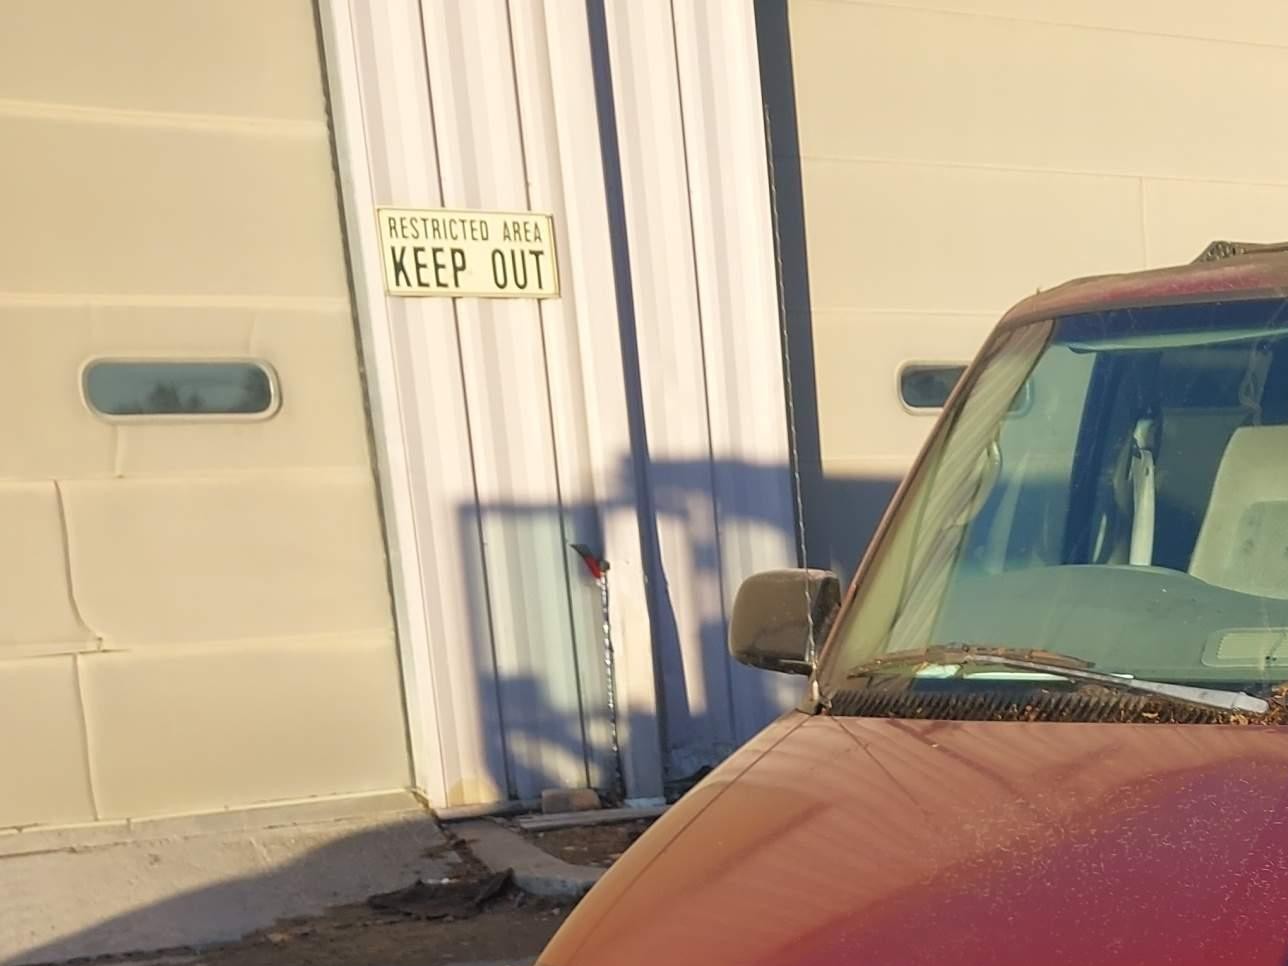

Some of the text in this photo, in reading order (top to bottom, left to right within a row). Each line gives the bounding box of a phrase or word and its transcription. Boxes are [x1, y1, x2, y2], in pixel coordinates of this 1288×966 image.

[388, 216, 543, 243] RESTRICTED AREA
[390, 246, 545, 290] KEEP OUT
